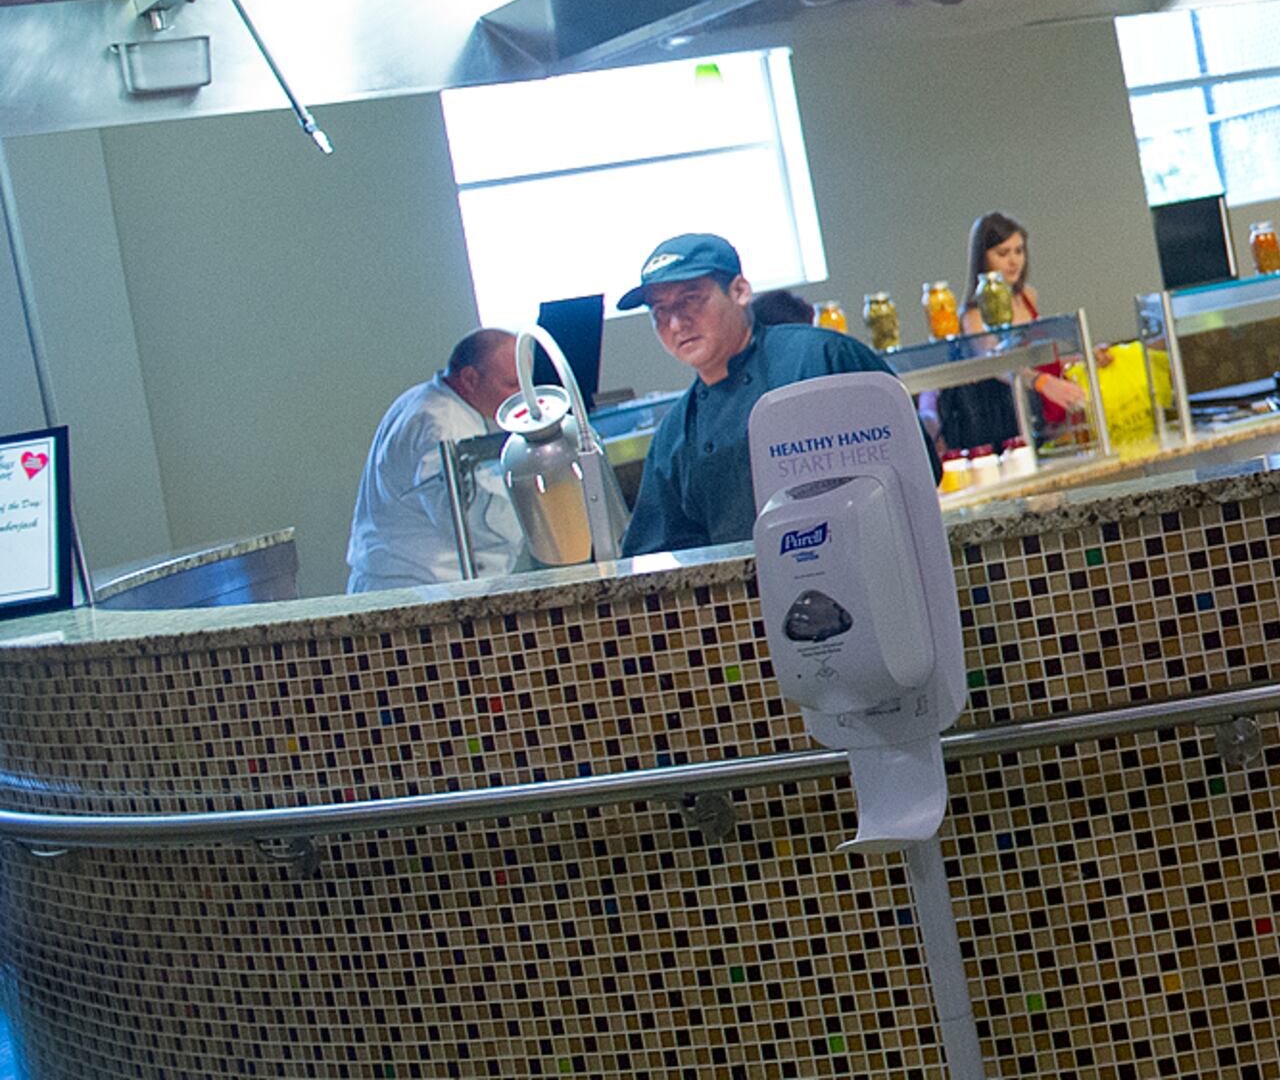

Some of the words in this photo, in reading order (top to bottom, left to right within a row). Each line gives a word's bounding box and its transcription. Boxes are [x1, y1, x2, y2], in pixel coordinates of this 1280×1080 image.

[768, 436, 834, 458] HEALTHY
[838, 425, 892, 447] HANDS
[778, 451, 834, 478] START
[839, 443, 891, 467] HERE
